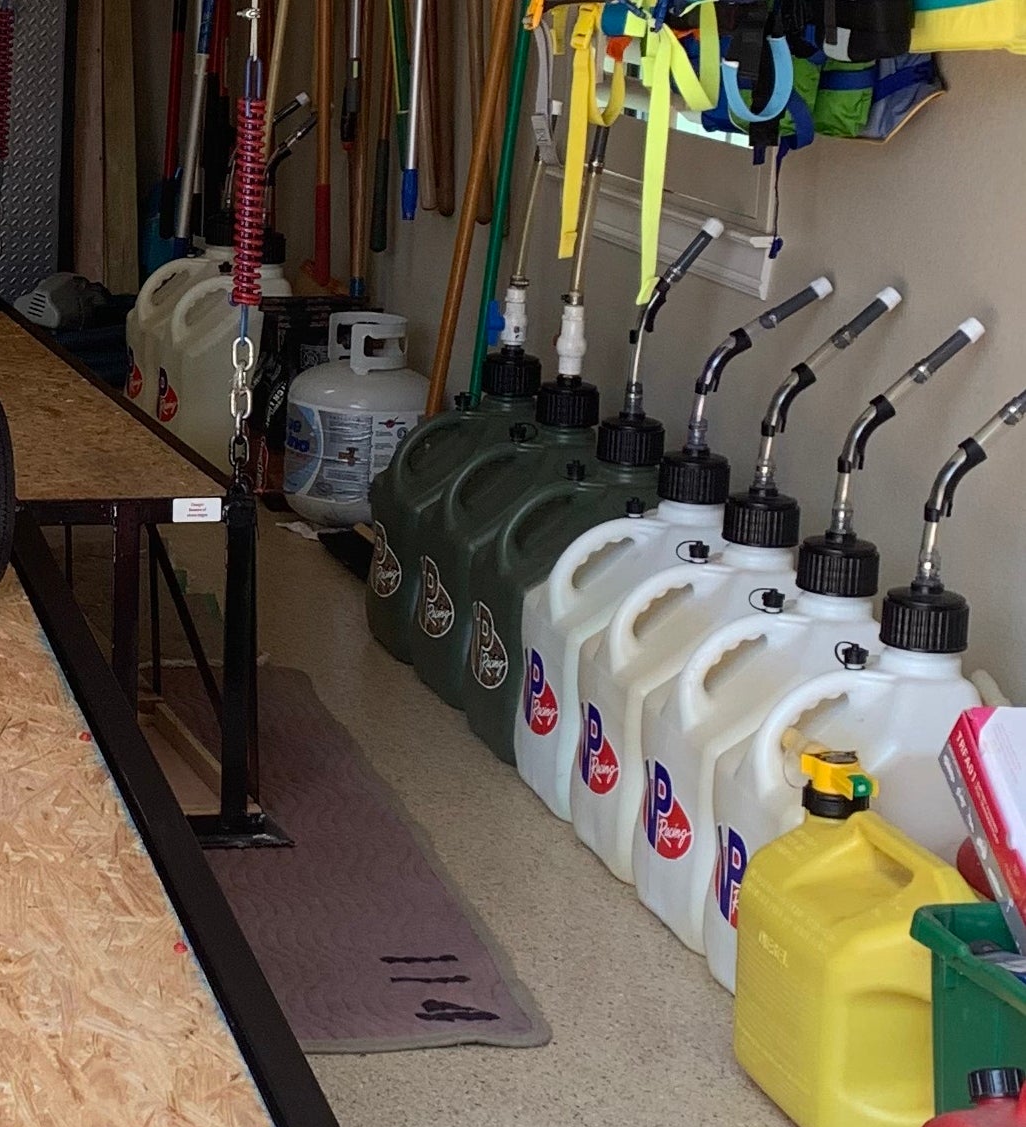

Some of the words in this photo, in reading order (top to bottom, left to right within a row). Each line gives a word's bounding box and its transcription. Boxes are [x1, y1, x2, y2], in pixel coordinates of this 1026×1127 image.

[482, 652, 508, 677] Racing
[533, 699, 558, 726] Racing
[591, 756, 619, 784] Racing
[657, 819, 693, 848] Racing
